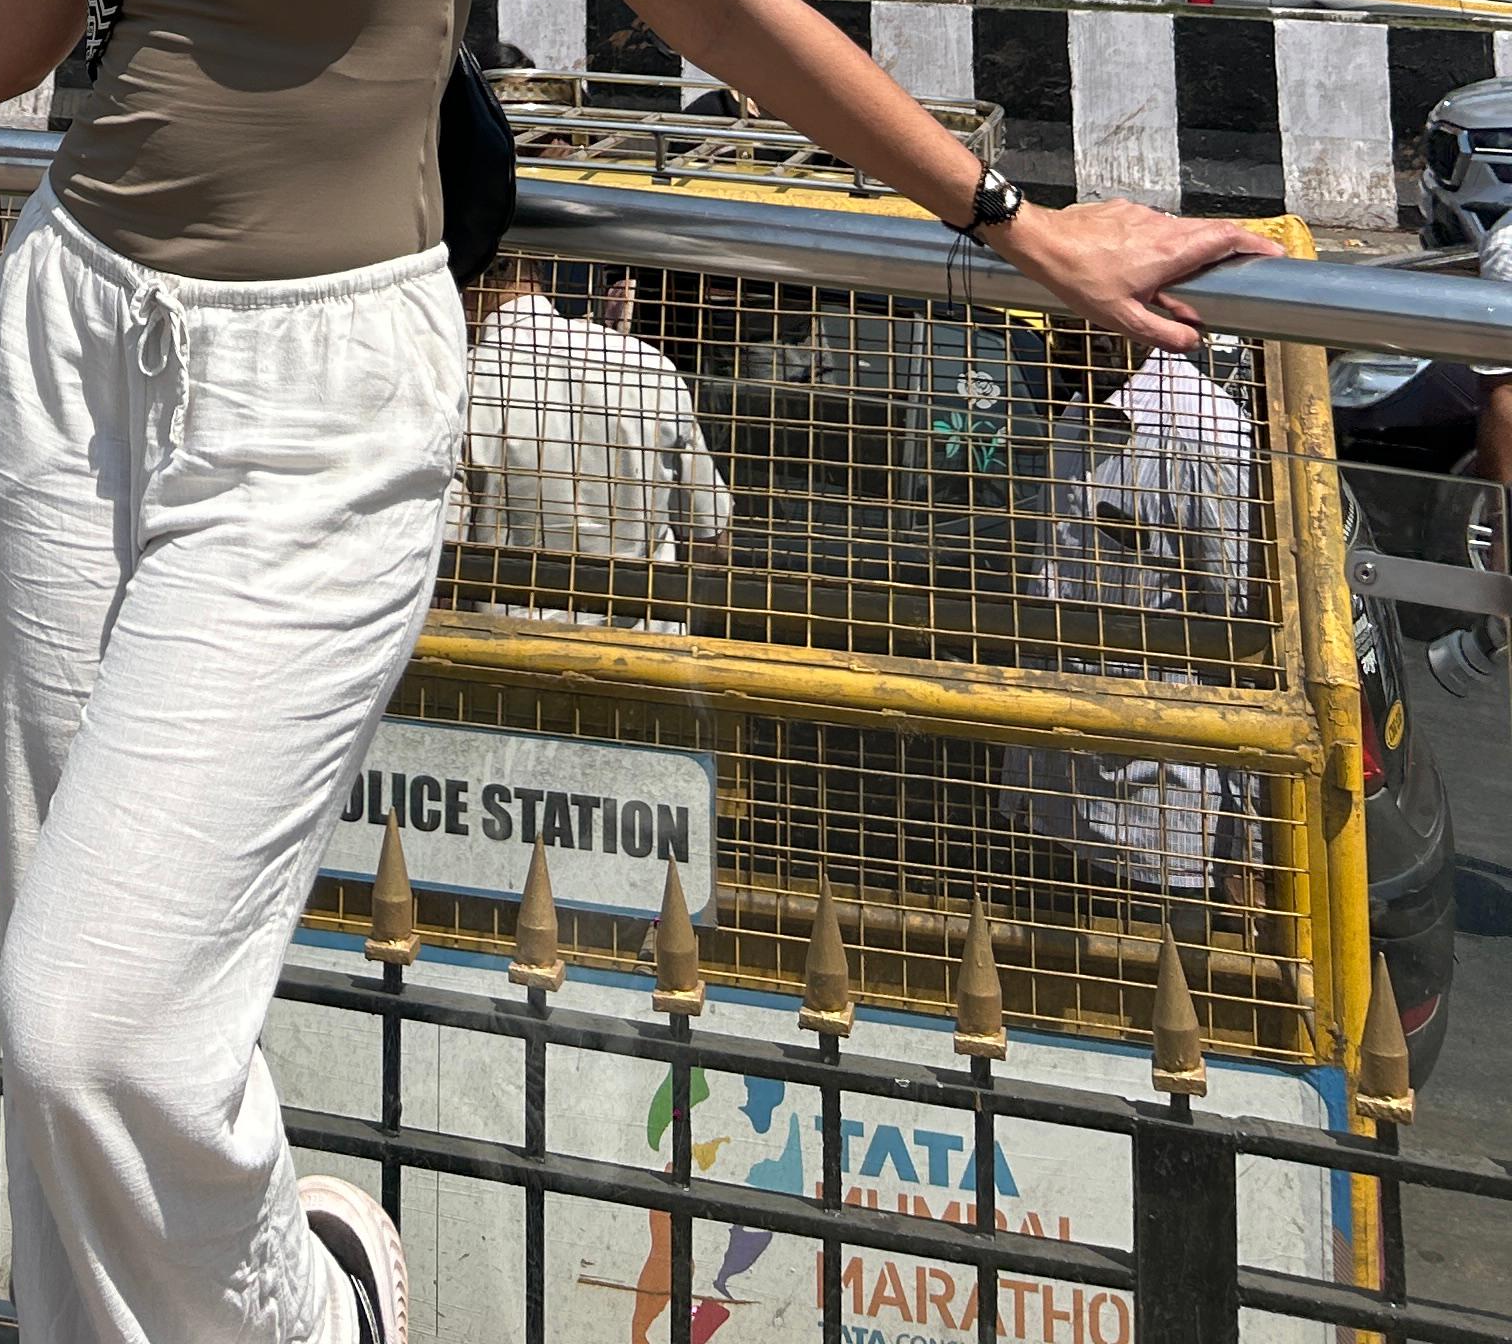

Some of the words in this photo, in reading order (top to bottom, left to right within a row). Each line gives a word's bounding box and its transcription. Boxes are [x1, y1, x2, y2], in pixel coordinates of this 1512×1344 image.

[340, 770, 469, 836] OLICE
[481, 784, 688, 863] STATION
[814, 1115, 1020, 1198] TATA
[816, 1251, 1131, 1344] MARATHO
